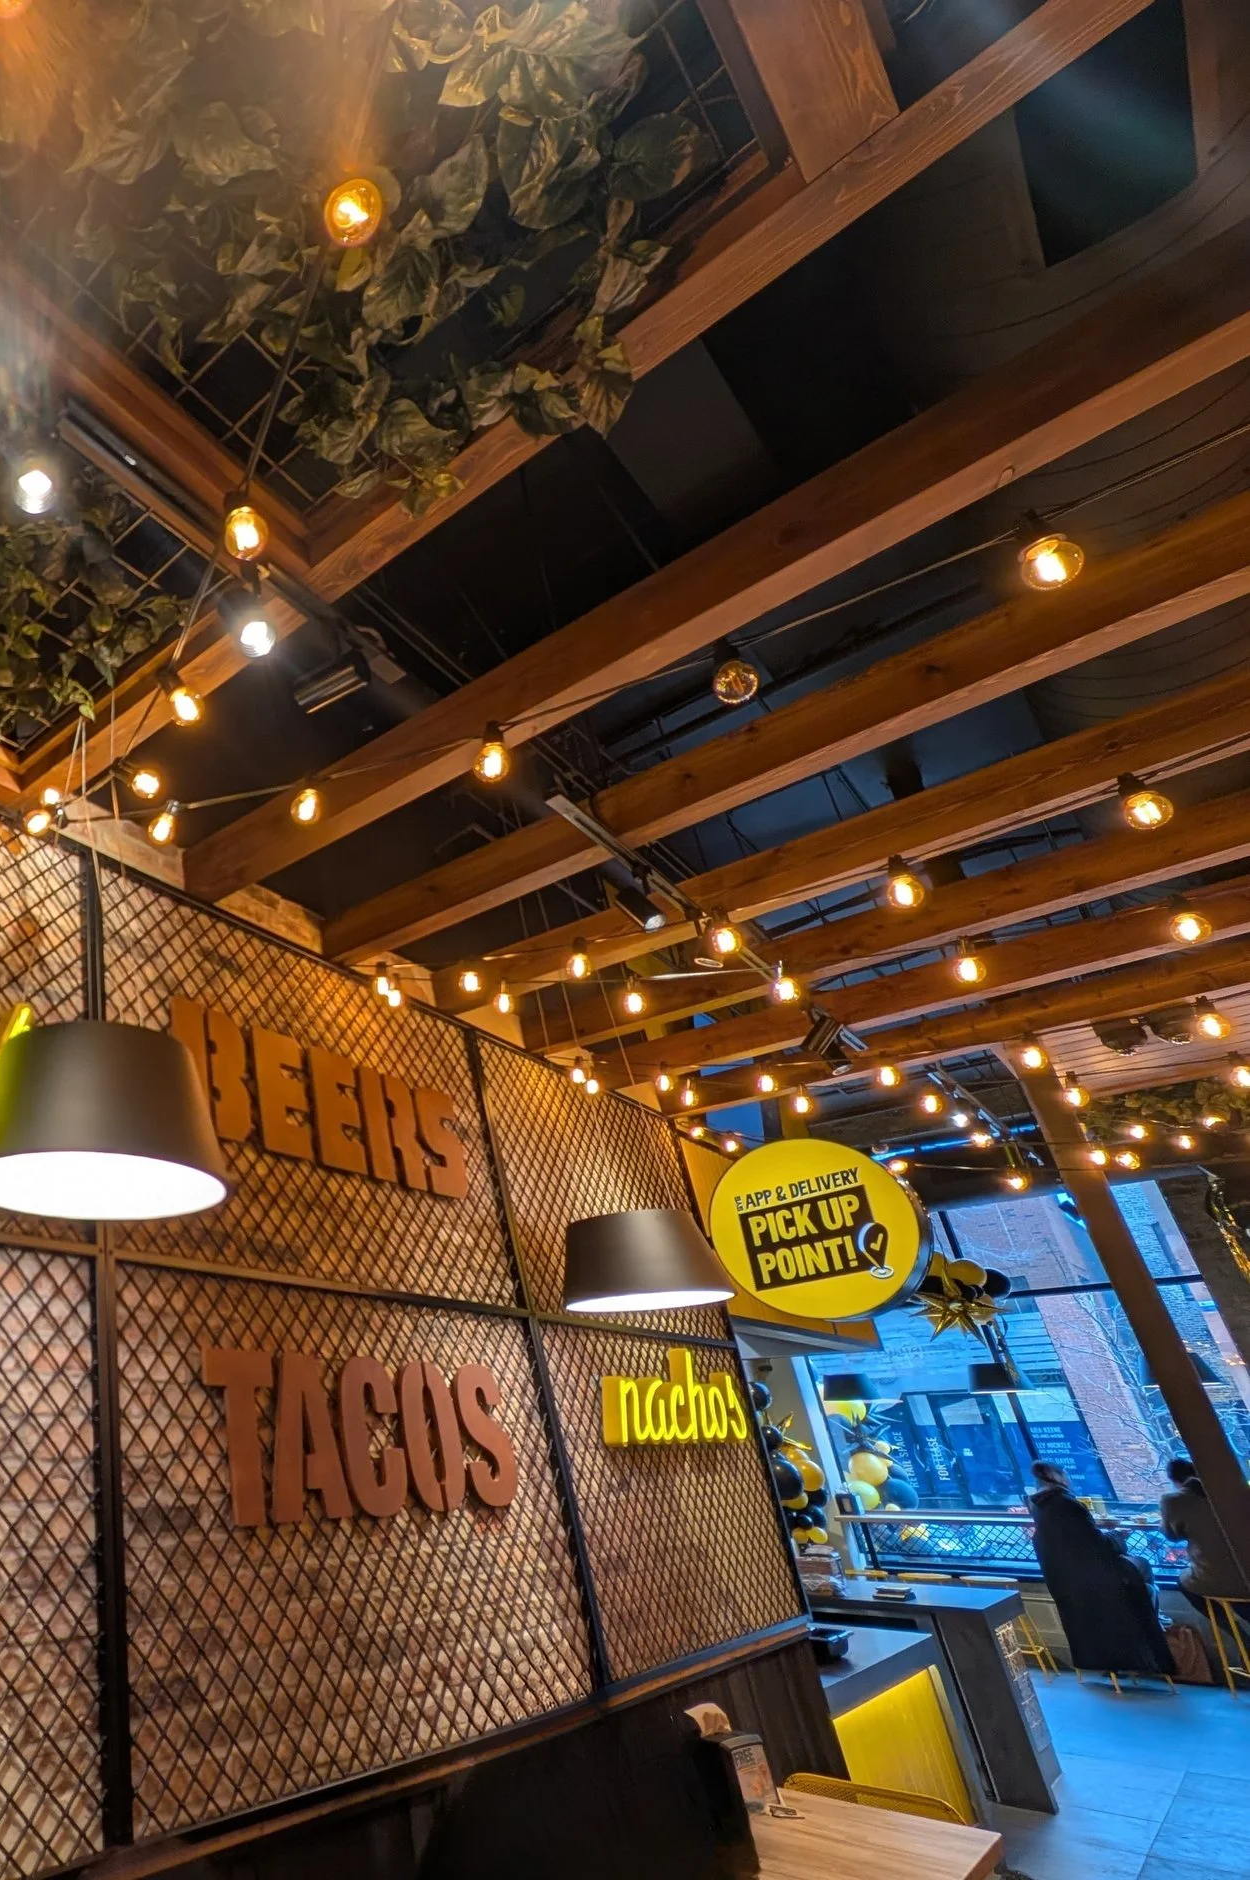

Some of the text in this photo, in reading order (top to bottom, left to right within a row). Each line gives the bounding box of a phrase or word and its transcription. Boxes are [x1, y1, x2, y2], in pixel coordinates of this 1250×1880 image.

[171, 994, 468, 1200] BEERS
[745, 1189, 772, 1210] APP
[775, 1185, 788, 1202] &
[788, 1166, 860, 1199] DELIVERY
[747, 1193, 861, 1248] PICK UP
[756, 1235, 859, 1285] POINT!
[616, 1349, 748, 1445] nachos
[201, 1346, 519, 1528] TACOS
[892, 1431, 920, 1488] RETAIL SPACE
[925, 1436, 951, 1481] FOR LEASE
